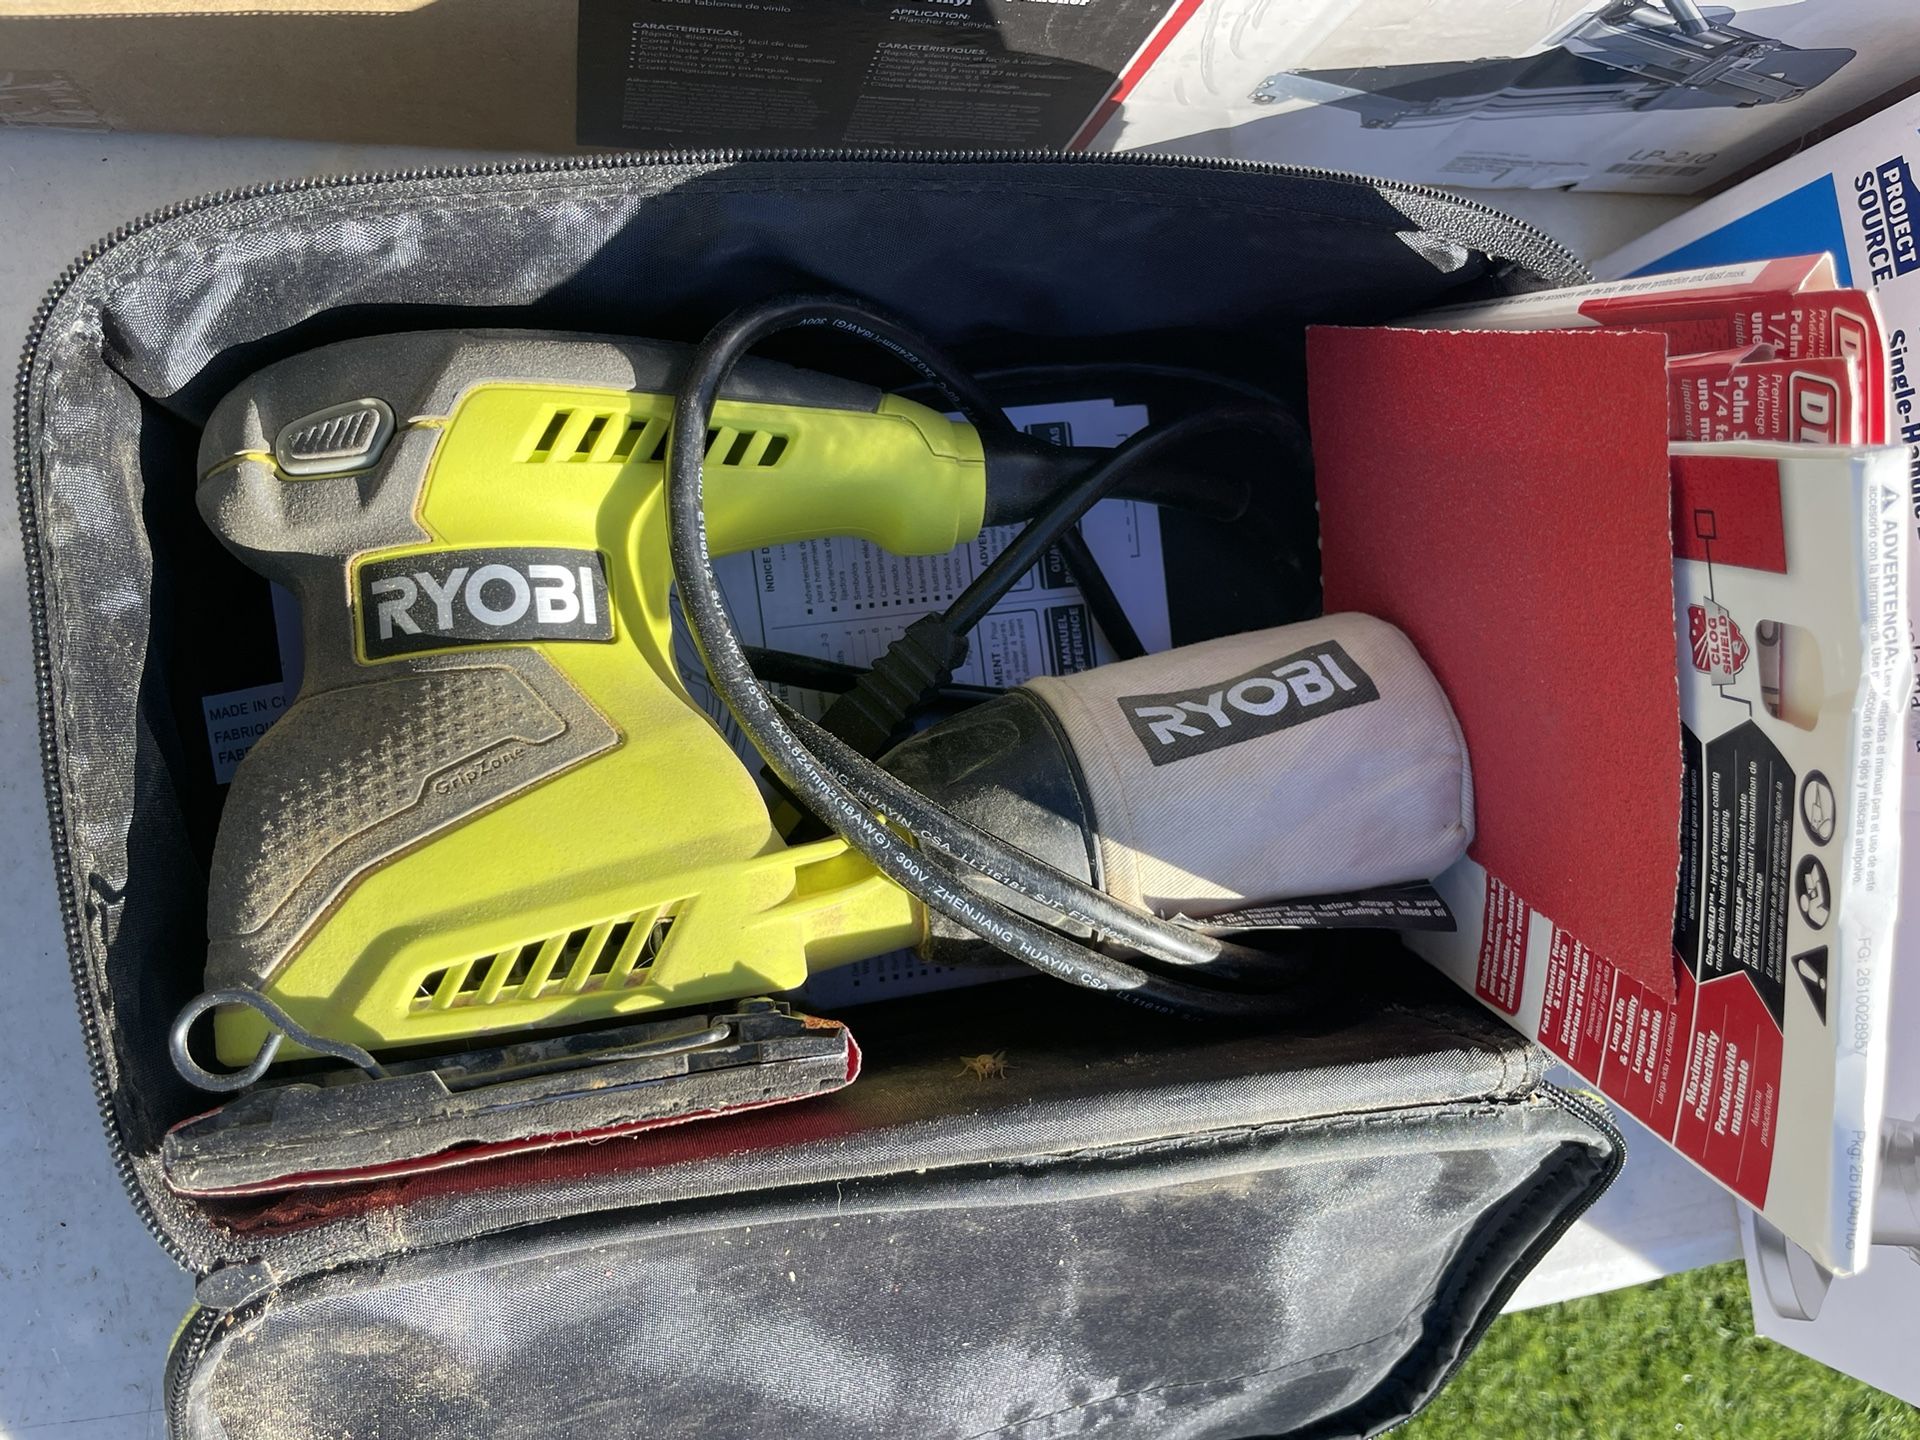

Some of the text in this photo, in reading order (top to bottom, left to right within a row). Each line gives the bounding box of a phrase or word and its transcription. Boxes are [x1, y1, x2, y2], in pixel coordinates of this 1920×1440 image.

[1882, 166, 1916, 265] PROJECT
[1688, 273, 1705, 282] and
[1750, 312, 1763, 344] une
[1790, 310, 1802, 358] Palm
[1680, 379, 1695, 426] Lijadoras
[1696, 378, 1709, 411] une
[1713, 378, 1729, 416] 1/4
[1732, 376, 1748, 424] Palm
[1754, 374, 1768, 435] Mélange
[1770, 374, 1782, 434] Premium
[1864, 484, 1880, 538] accesorio
[762, 556, 775, 592] ÍNDICE
[824, 548, 836, 603] Advertencias
[943, 557, 952, 590] Pedidos
[953, 558, 962, 588] servicio
[1867, 540, 1879, 561] con
[371, 564, 597, 640] RYOBI
[799, 551, 812, 605] Advertencias
[814, 584, 824, 603] para
[838, 570, 848, 600] lijadora
[851, 561, 861, 600] Símbolos
[864, 560, 874, 599] Aspectos
[890, 563, 900, 596] Armado
[1882, 519, 1899, 666] ADVERTENCIA:
[1865, 576, 1884, 644] herramienta.
[1057, 614, 1072, 665] MANUEL
[1706, 617, 1721, 665] CLOG
[1716, 614, 1733, 674] SHIELD
[1869, 647, 1882, 667] Use
[209, 699, 268, 721] MADE IN
[1134, 654, 1357, 745] RYOBI
[1860, 740, 1872, 757] los
[1861, 725, 1873, 738] de
[1856, 758, 1870, 781] ojos
[858, 786, 912, 828] HUAYIN
[919, 826, 953, 852] CSA
[1708, 771, 1723, 885] Hi-performance coating
[1773, 791, 1783, 822] reduce
[1855, 791, 1868, 835] máscara
[1866, 757, 1884, 867] manual para uso de
[1734, 792, 1748, 883] Revêtement haute
[1741, 760, 1759, 965] performance réduisant l'accumulation de
[895, 850, 931, 884] 300V
[1714, 808, 1731, 971] reduces pitch build-up & clogging.
[1770, 877, 1778, 895] alto
[1246, 911, 1281, 920] hazard
[1284, 908, 1311, 918] when
[1314, 909, 1339, 918] resin
[1342, 907, 1382, 918] coatings
[1398, 906, 1431, 918] linseed
[1253, 915, 1320, 927] been sanded.
[1319, 901, 1352, 910] before
[1750, 872, 1765, 970] poix et le bouchage
[1775, 868, 1786, 925] de la
[930, 883, 1015, 944] ZHENJIANG
[1018, 937, 1074, 980] HUAYIN
[1480, 892, 1497, 988] Diablo's premium
[1488, 921, 1503, 996] performance,
[1080, 973, 1108, 991] CSA
[1496, 938, 1512, 1002] Les feuilles
[1505, 933, 1521, 1009] améliorent le
[1540, 959, 1558, 1034] Fast Material
[1552, 943, 1568, 1009] & Long Life
[1848, 937, 1874, 1057] FG: 2610028957
[1559, 977, 1577, 1044] Enlèvement
[1566, 951, 1591, 1060] matériau et longue
[1608, 996, 1626, 1052] Long Life
[1618, 993, 1639, 1066] & Durability
[1630, 1007, 1650, 1074] Longue vie
[1642, 1008, 1663, 1084] et durabilité
[1663, 1010, 1677, 1056] durabilidad
[1655, 1080, 1667, 1105] Larga
[1659, 1062, 1670, 1079] vida
[1683, 1030, 1709, 1105] Maximum
[1694, 1028, 1721, 1122] Productivity
[1712, 1041, 1737, 1135] Productivité
[1728, 1058, 1749, 1136] maximale
[1846, 1129, 1865, 1160] Pkg:
